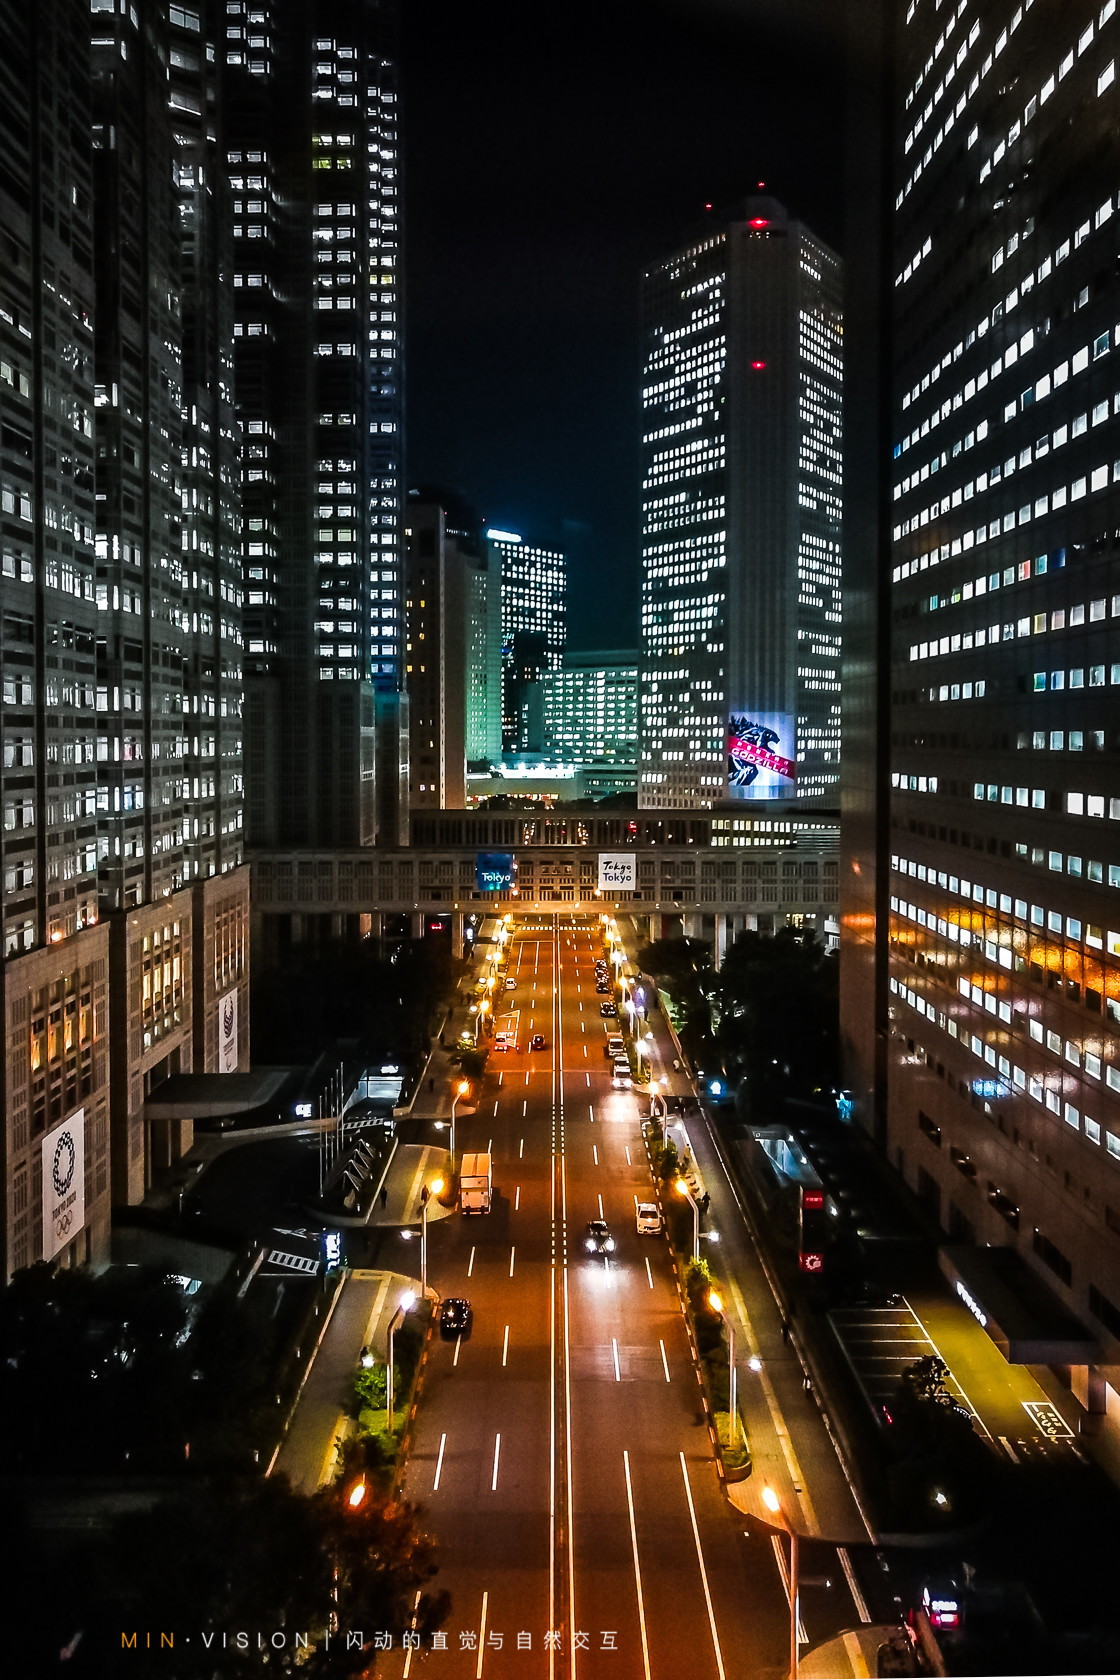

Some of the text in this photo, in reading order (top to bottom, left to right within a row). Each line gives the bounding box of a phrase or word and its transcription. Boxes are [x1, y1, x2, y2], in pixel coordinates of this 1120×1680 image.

[731, 748, 789, 775] GODZILLA
[603, 861, 632, 874] Tokyo
[482, 871, 511, 884] Tokyo
[603, 873, 632, 884] Tokyo
